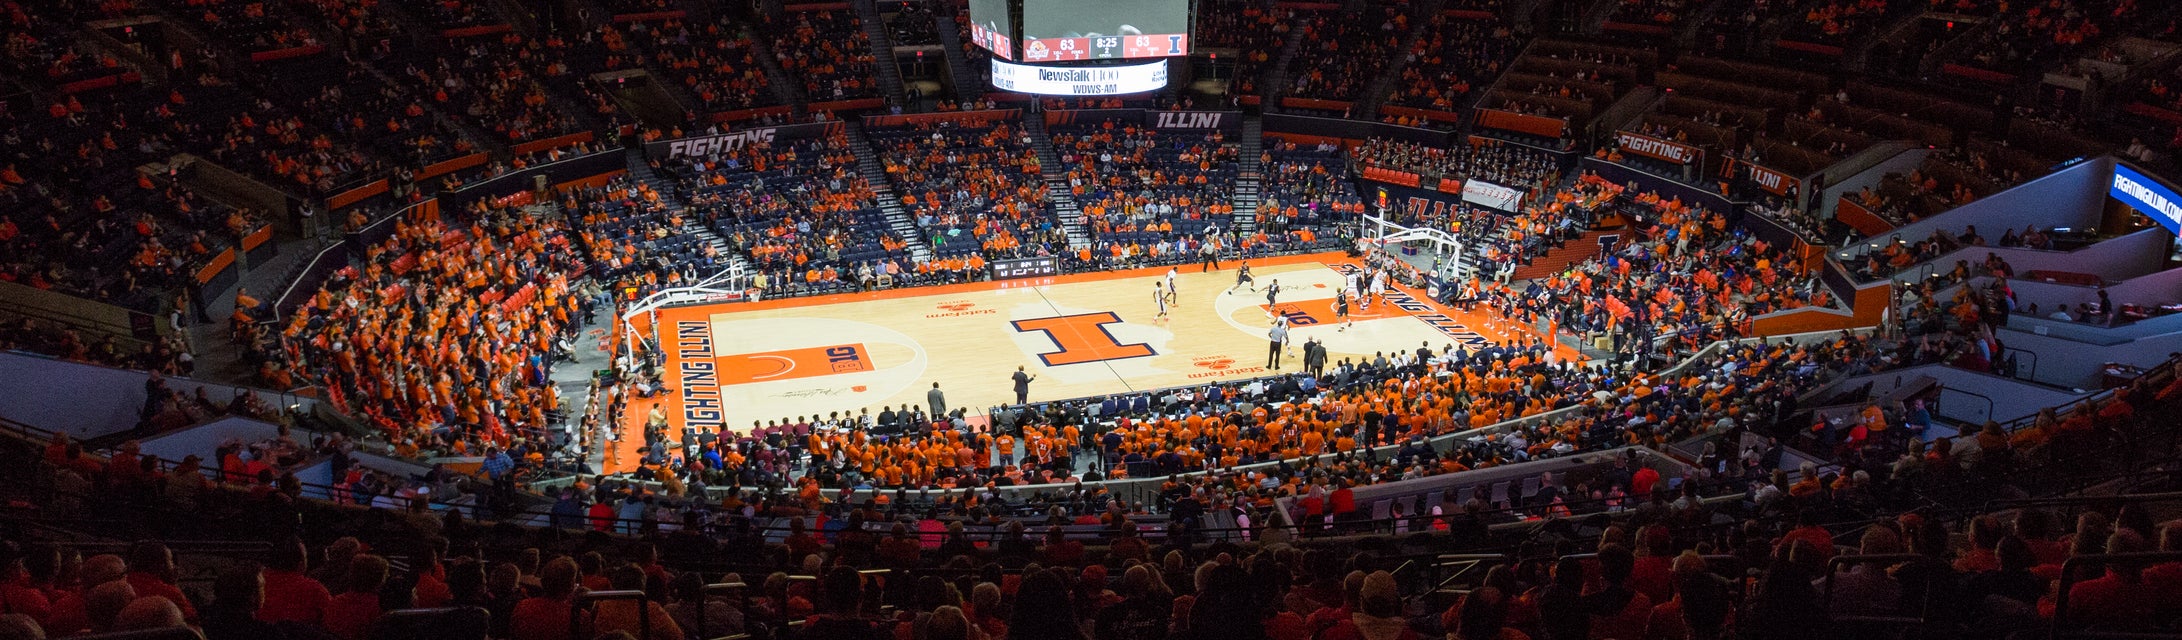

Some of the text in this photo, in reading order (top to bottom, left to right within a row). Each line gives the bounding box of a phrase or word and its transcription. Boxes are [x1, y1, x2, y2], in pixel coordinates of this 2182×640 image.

[1060, 39, 1075, 50] 63
[1096, 37, 1117, 48] 8:25
[1136, 36, 1150, 47] 63
[1038, 68, 1090, 82] NewsTalk
[1072, 84, 1118, 94] WDWS-AM
[1156, 112, 1222, 128] ILLINI
[669, 128, 776, 159] FIGHTING
[1619, 134, 1684, 160] FIGHTING
[2113, 173, 2182, 225] FIGHTINGILLINI.COM
[677, 320, 713, 359] ILLINI
[1010, 311, 1160, 367] I
